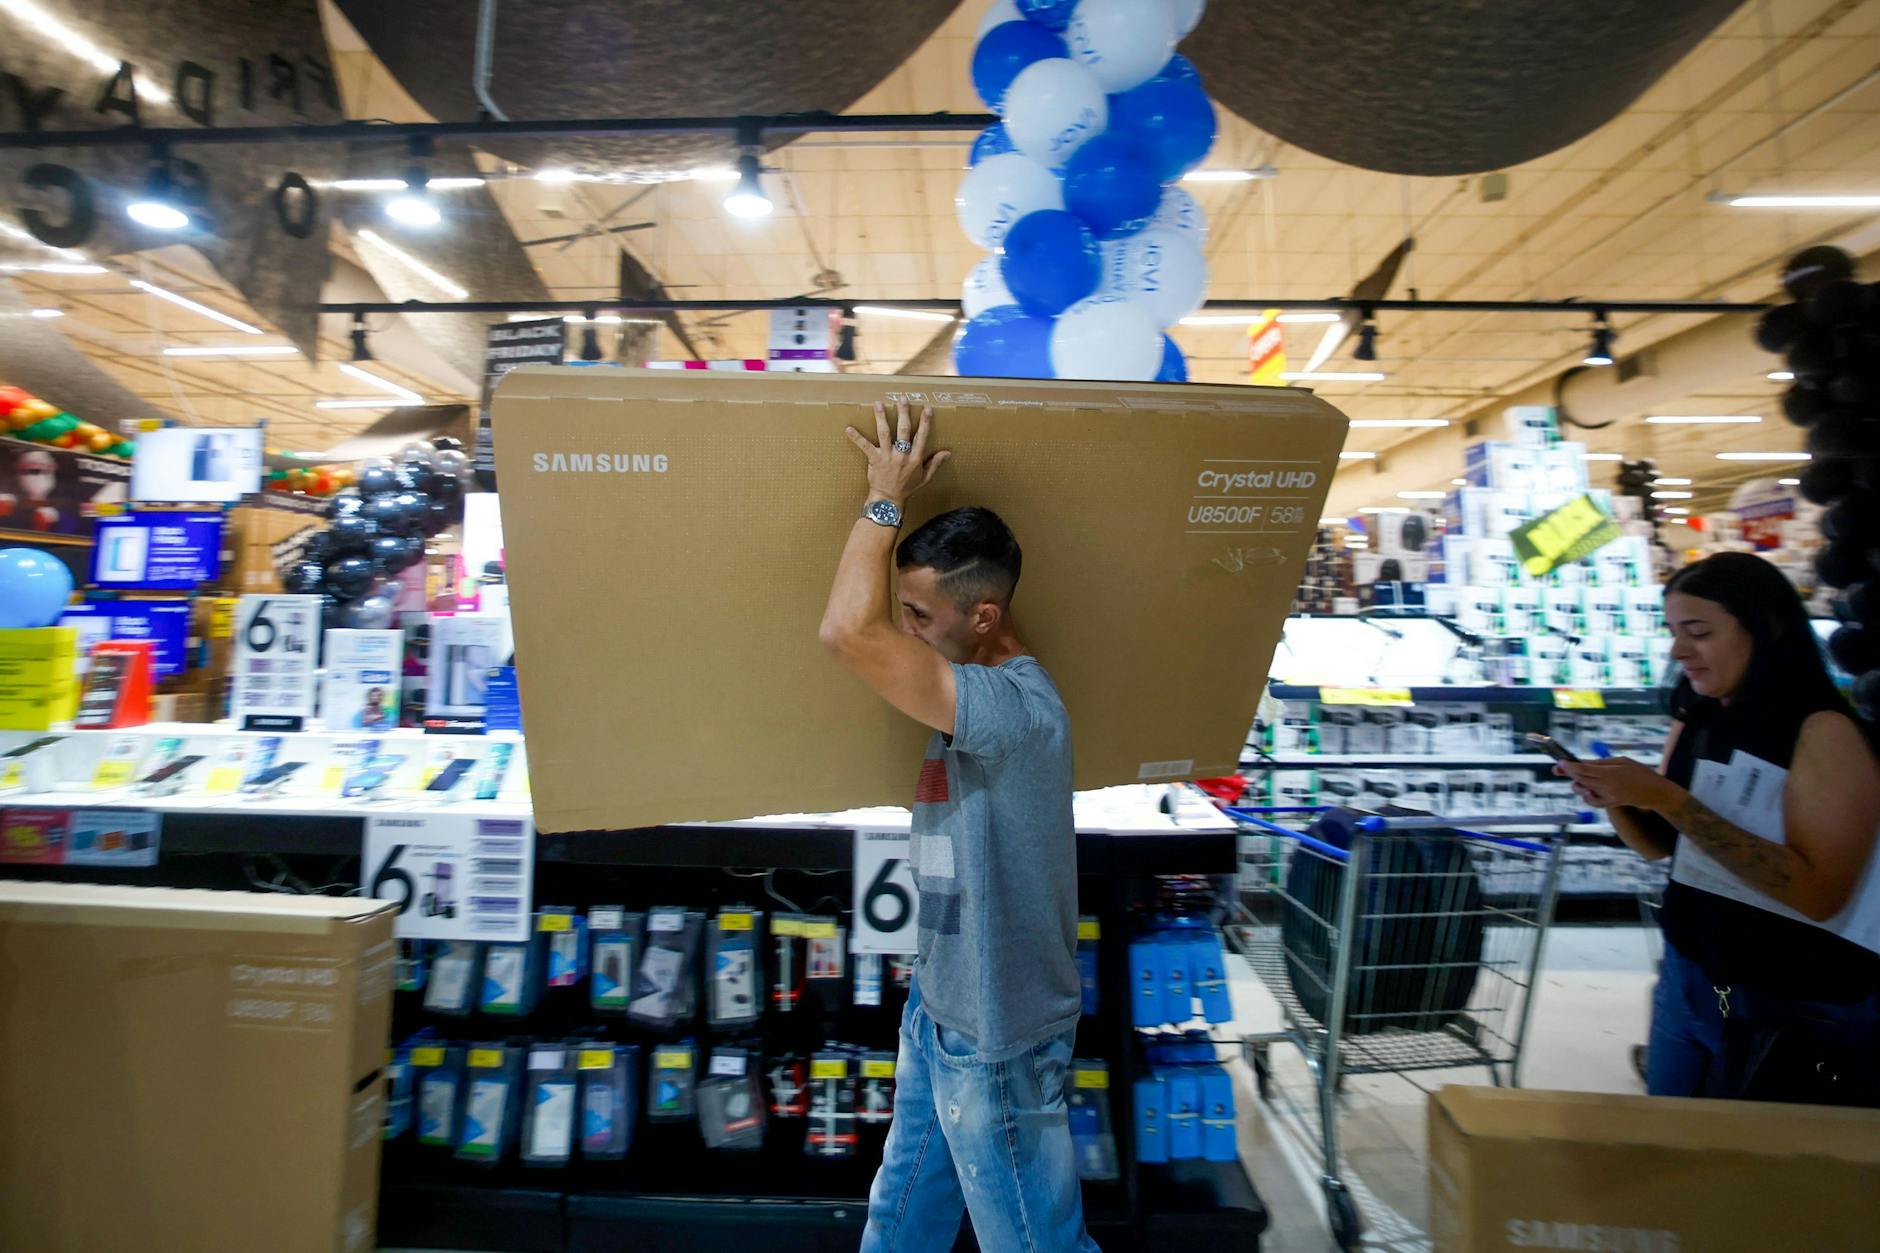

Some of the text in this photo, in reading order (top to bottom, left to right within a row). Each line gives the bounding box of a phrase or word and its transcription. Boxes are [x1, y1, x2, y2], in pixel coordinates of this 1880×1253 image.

[533, 453, 669, 473] SAMSUNG
[1197, 470, 1316, 493] Crystal UHD
[1187, 506, 1263, 523] U8500F
[246, 600, 276, 652] 6
[372, 845, 415, 916] 6
[864, 859, 912, 933] 6
